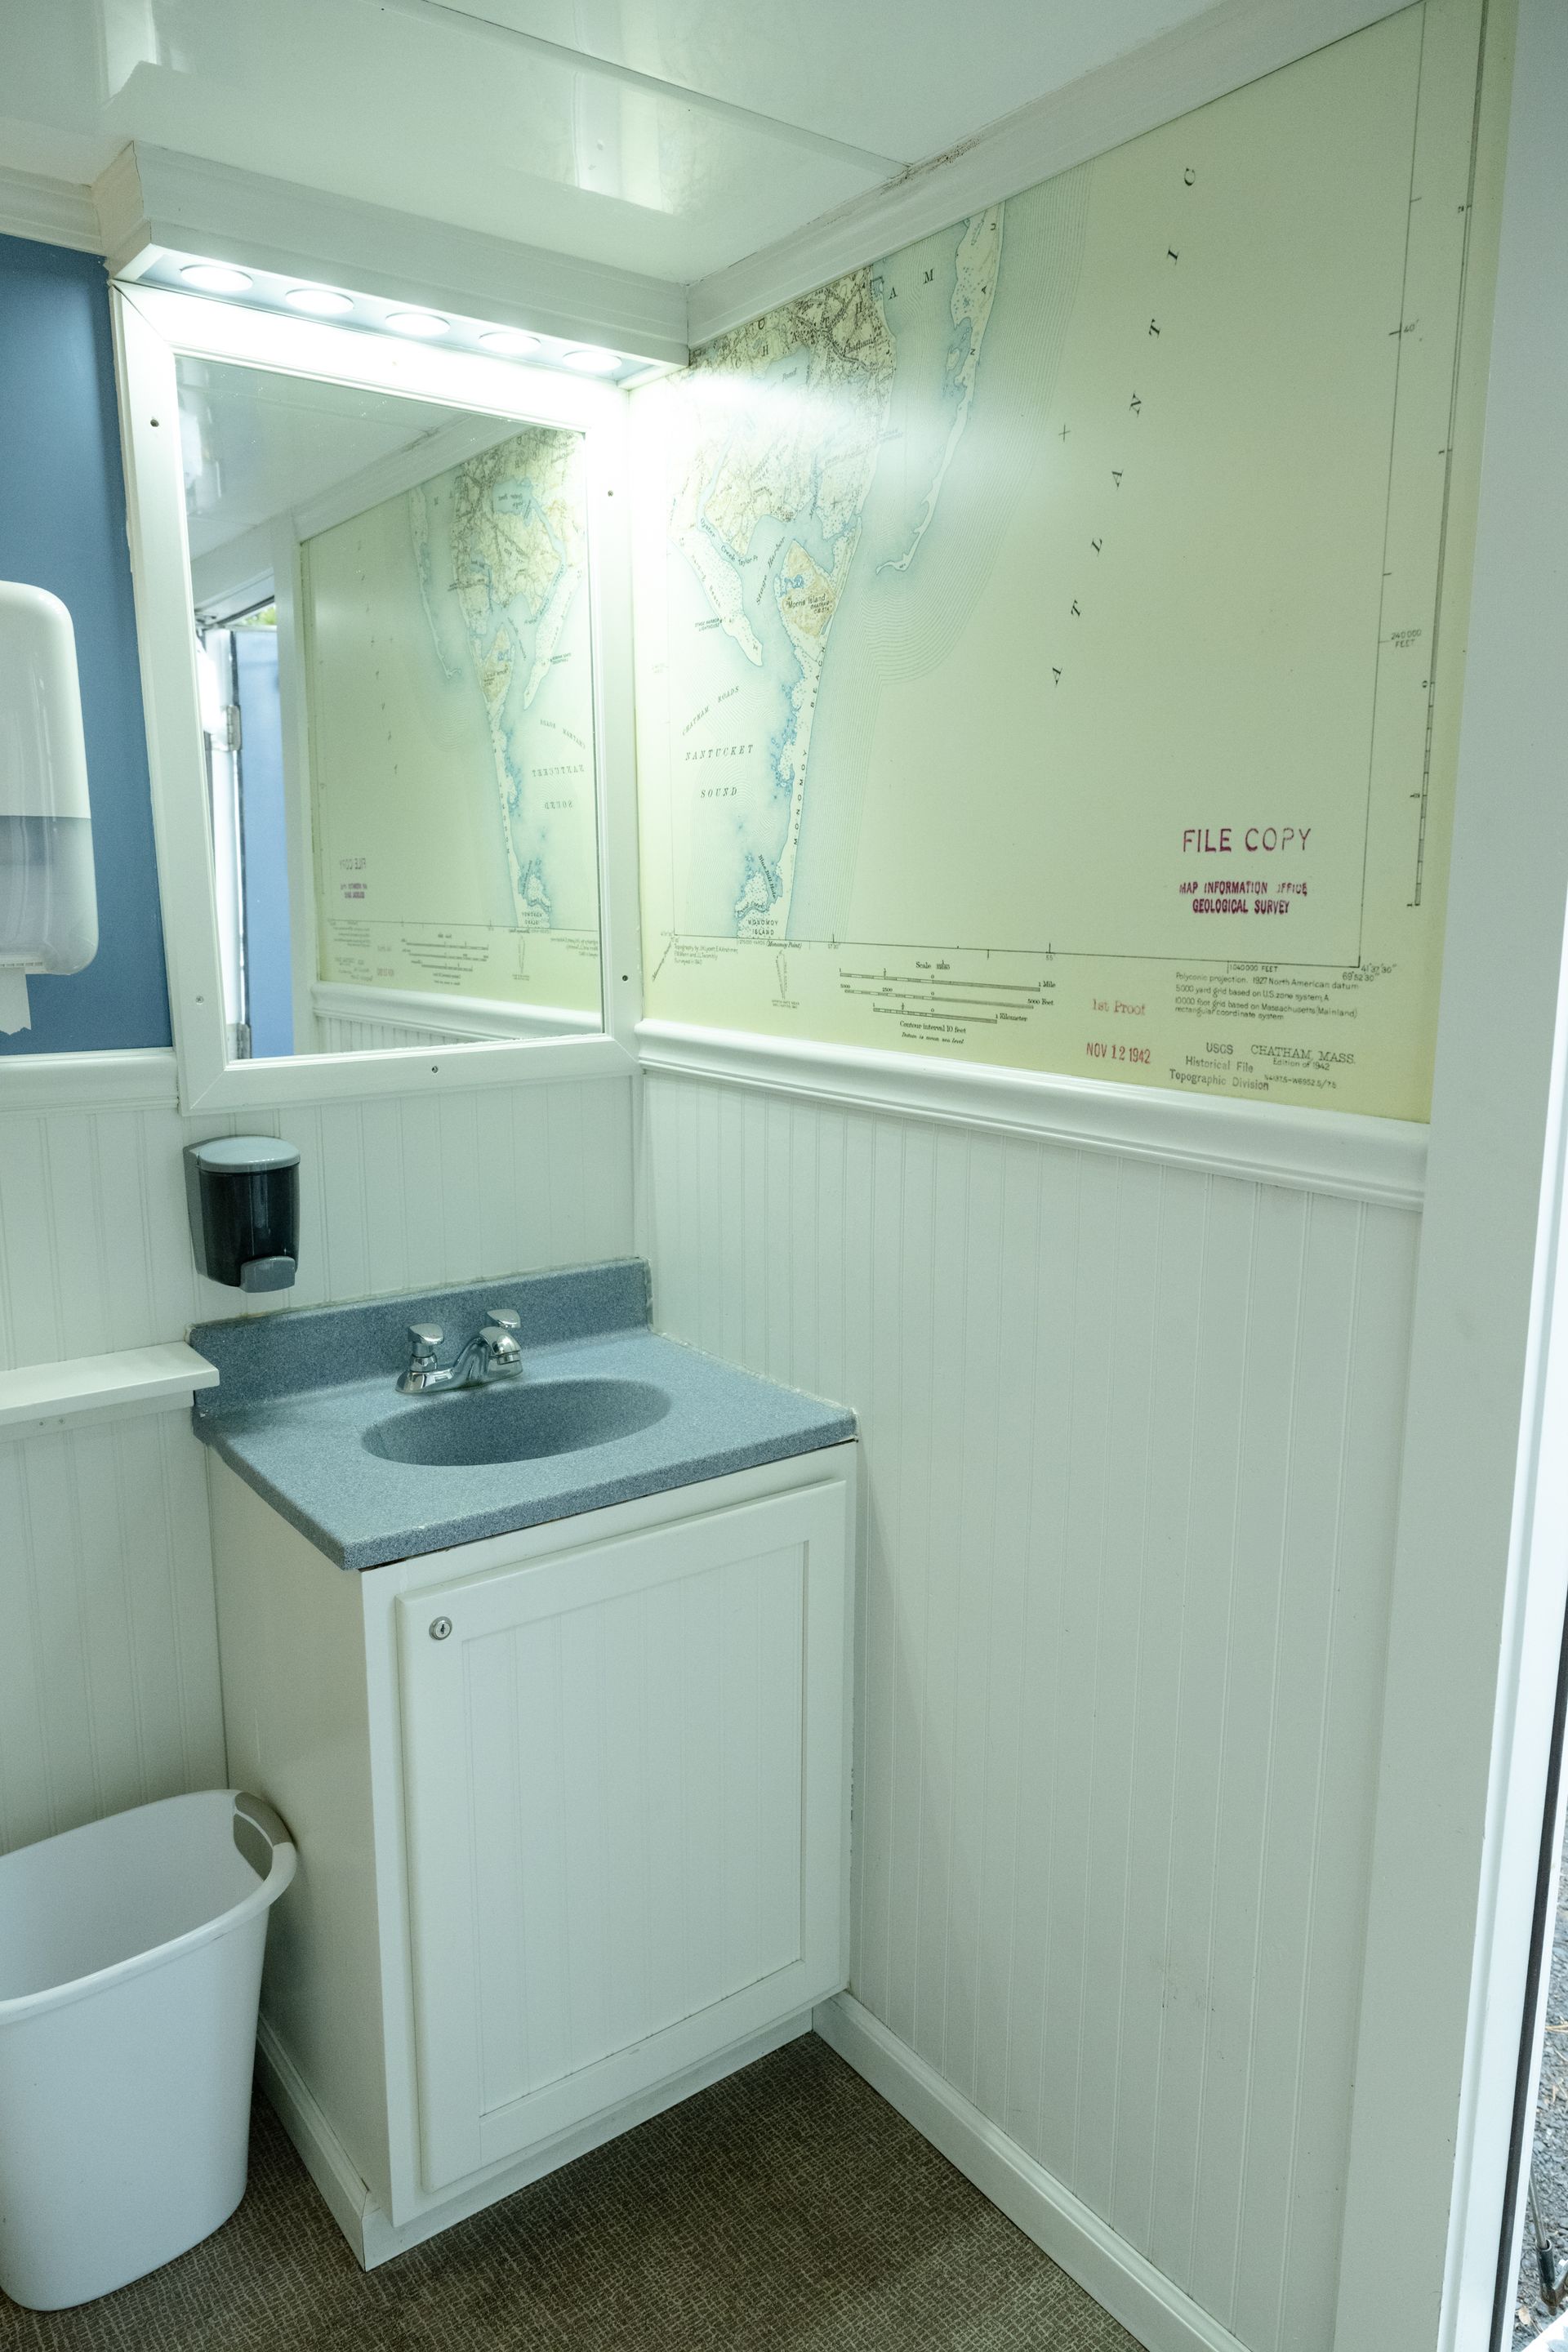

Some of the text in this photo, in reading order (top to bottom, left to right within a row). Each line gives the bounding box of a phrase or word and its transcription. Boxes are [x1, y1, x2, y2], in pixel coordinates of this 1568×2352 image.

[808, 593, 826, 604] Island
[684, 744, 755, 761] NANTUCKET
[700, 786, 738, 799] SOUND
[1183, 826, 1312, 853] FILE COPY
[1178, 881, 1199, 894] MAP
[1204, 880, 1268, 896] INFORMATION
[1192, 898, 1290, 915] GEOLOGICAL SURVEY
[1042, 980, 1057, 988] Mile
[1175, 972, 1207, 982] Polyconic
[1252, 976, 1267, 985] 1927
[1268, 977, 1290, 986] North
[1291, 978, 1330, 988] American
[1331, 980, 1359, 990] datum
[1195, 987, 1211, 995] yard
[1212, 987, 1227, 999] grid
[1228, 988, 1250, 997] based
[1092, 998, 1146, 1016] 1st Proof
[1174, 1005, 1285, 1021] rectangular coordinate system
[1196, 998, 1210, 1006] foot
[1212, 999, 1226, 1010] grid
[1227, 1000, 1250, 1009] based
[1261, 1003, 1316, 1014] Massachusetts
[999, 1013, 1028, 1022] Kilometer
[899, 1019, 967, 1034] Contour interval 10 feet
[1085, 1041, 1152, 1064] NOV 12 1942
[1205, 1041, 1234, 1055] USGS
[1185, 1054, 1254, 1073] Historical File
[1272, 1057, 1331, 1071] Edition of 1942
[1169, 1067, 1270, 1092] Topographic Division
